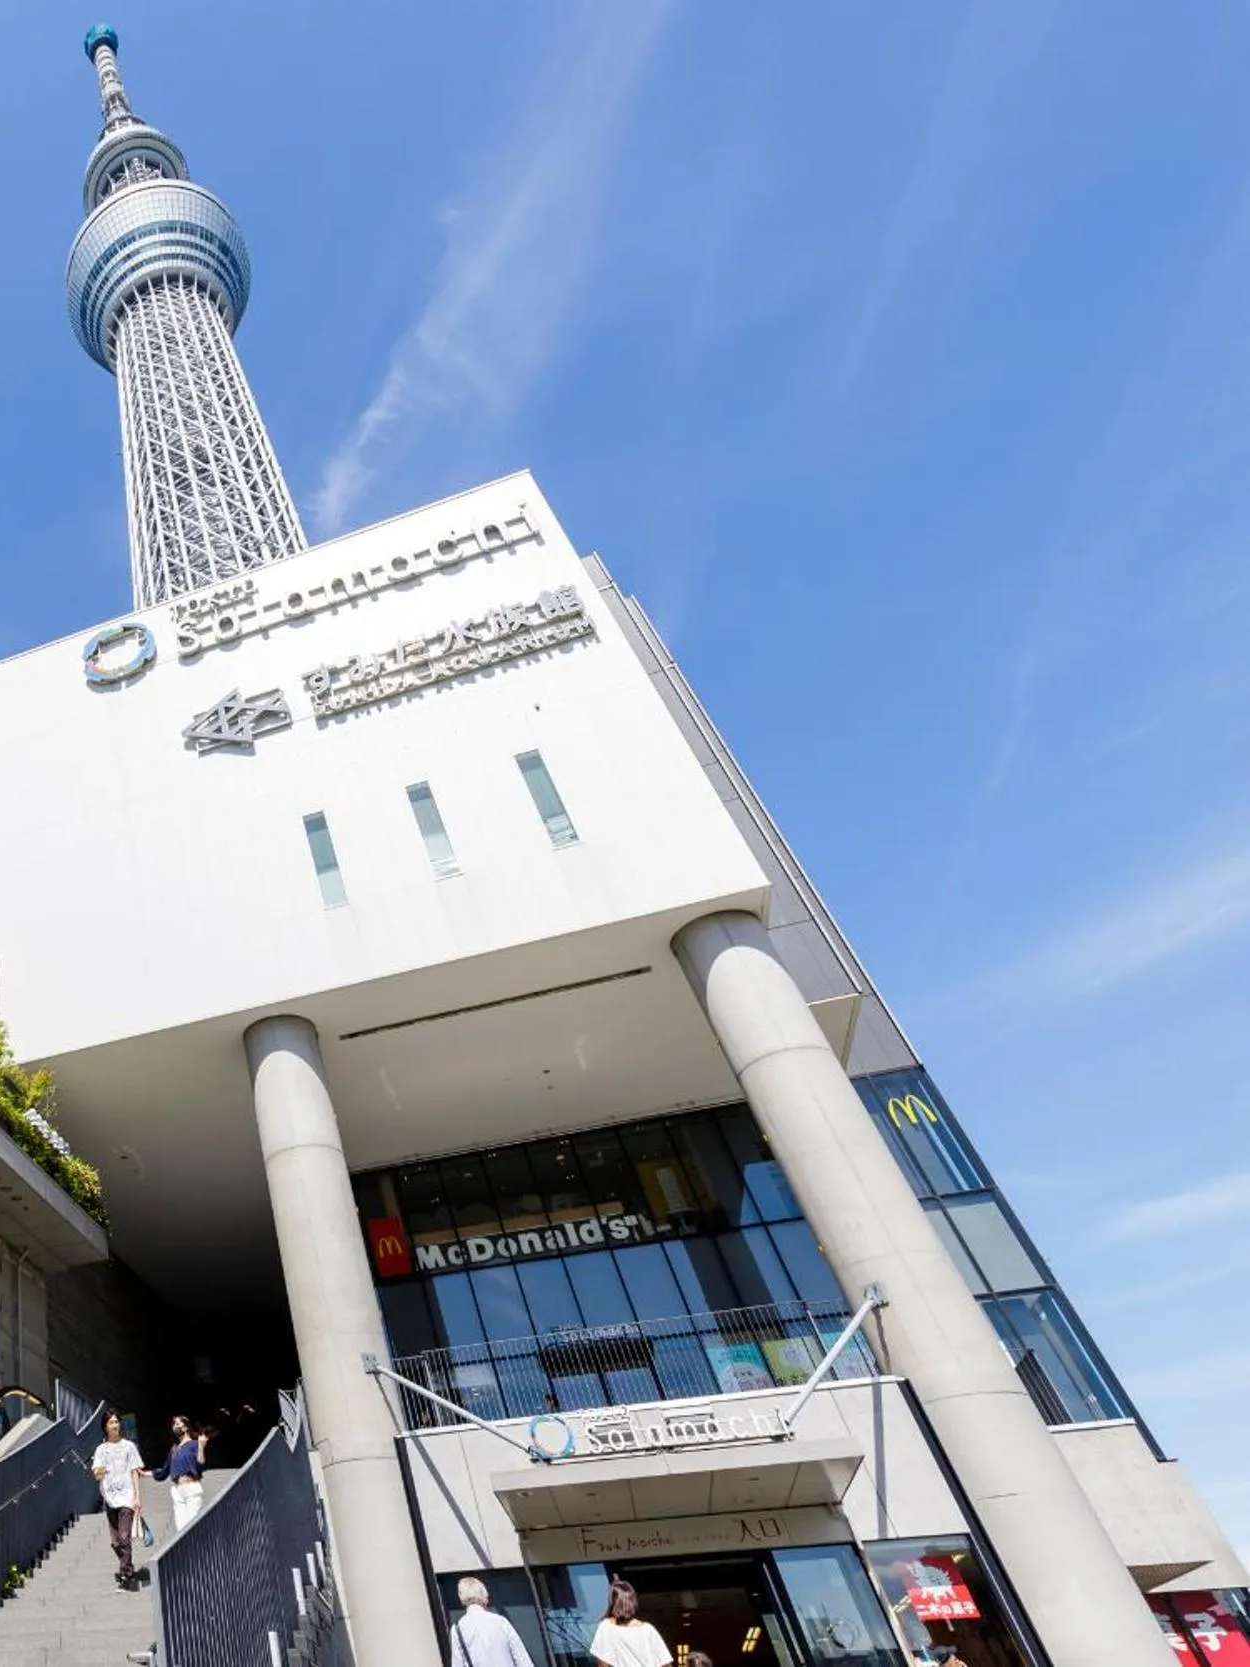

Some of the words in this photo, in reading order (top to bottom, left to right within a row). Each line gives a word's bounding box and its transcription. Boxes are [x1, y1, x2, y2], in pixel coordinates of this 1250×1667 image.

[416, 1213, 632, 1271] McDonald's
[588, 1408, 794, 1453] Solamachi
[739, 1518, 782, 1544] 入口
